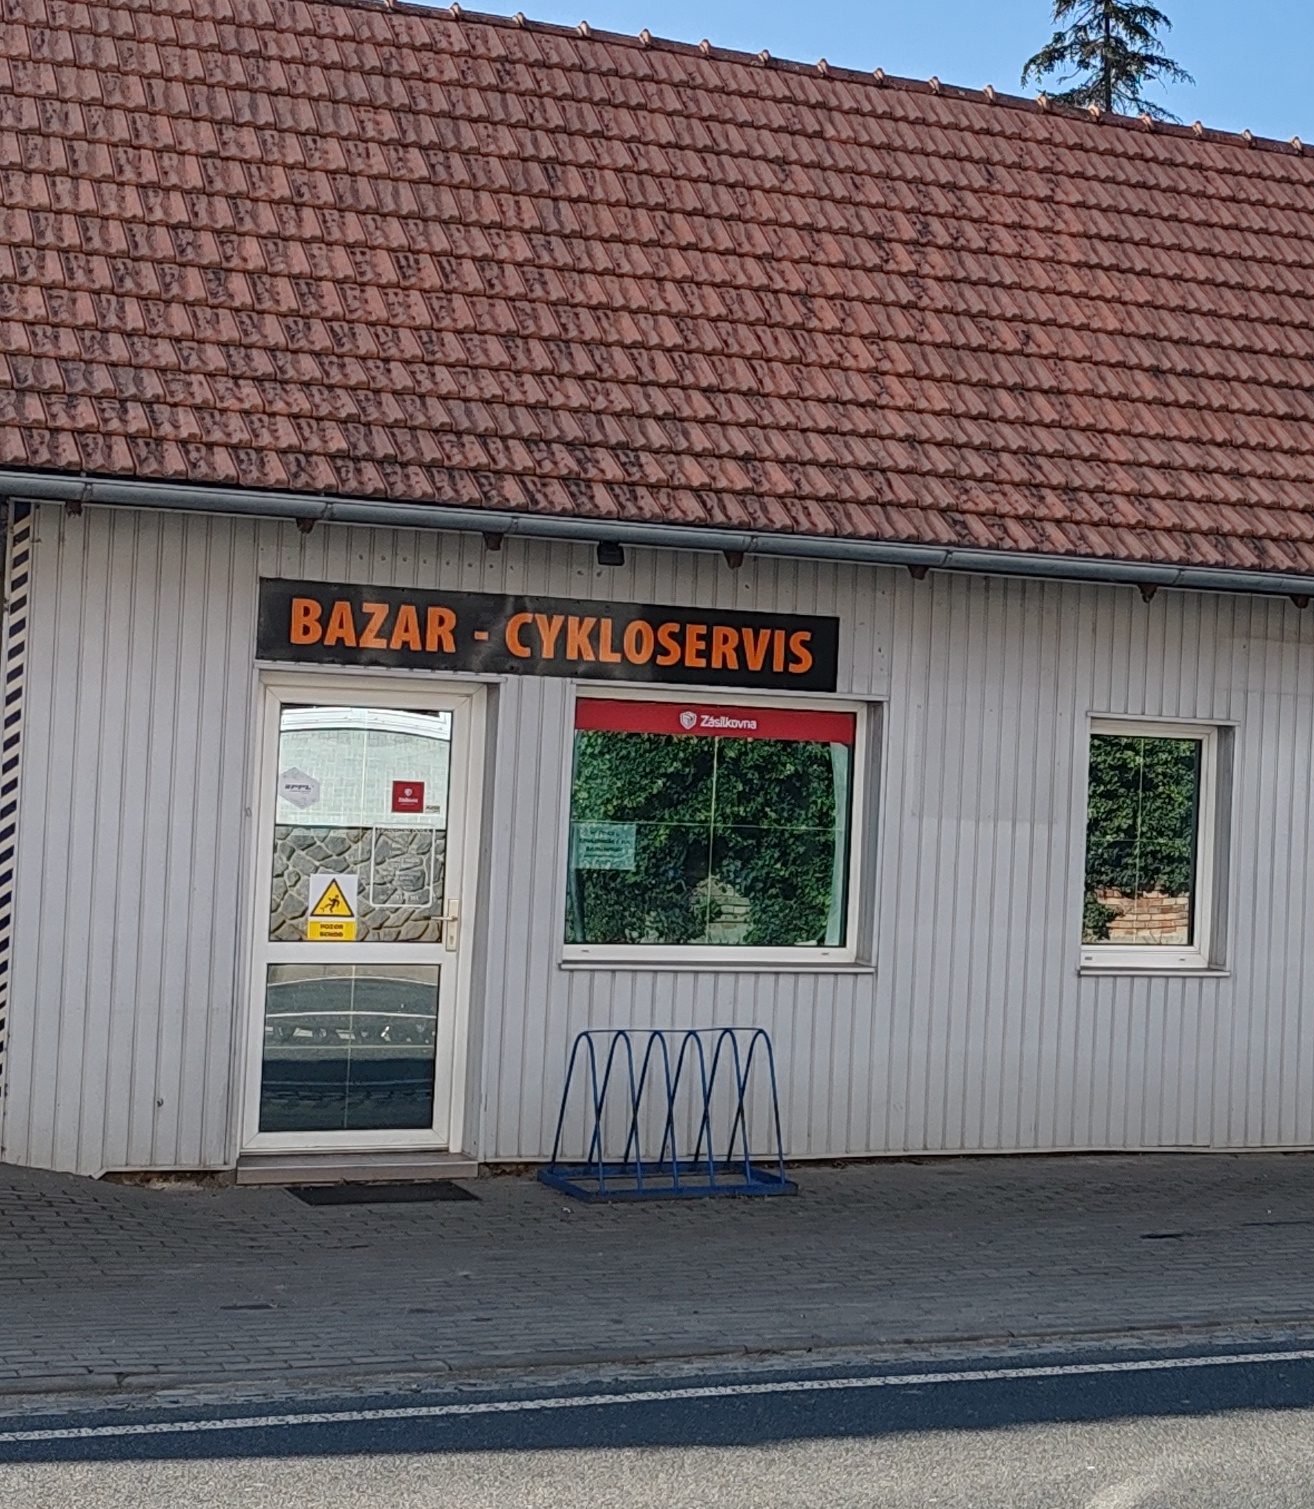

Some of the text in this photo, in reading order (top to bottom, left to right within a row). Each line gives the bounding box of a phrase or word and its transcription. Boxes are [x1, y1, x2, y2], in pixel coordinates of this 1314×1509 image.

[290, 597, 813, 673] BAZAR - CYKLOSERVIS
[700, 714, 757, 730] Zásilkovna
